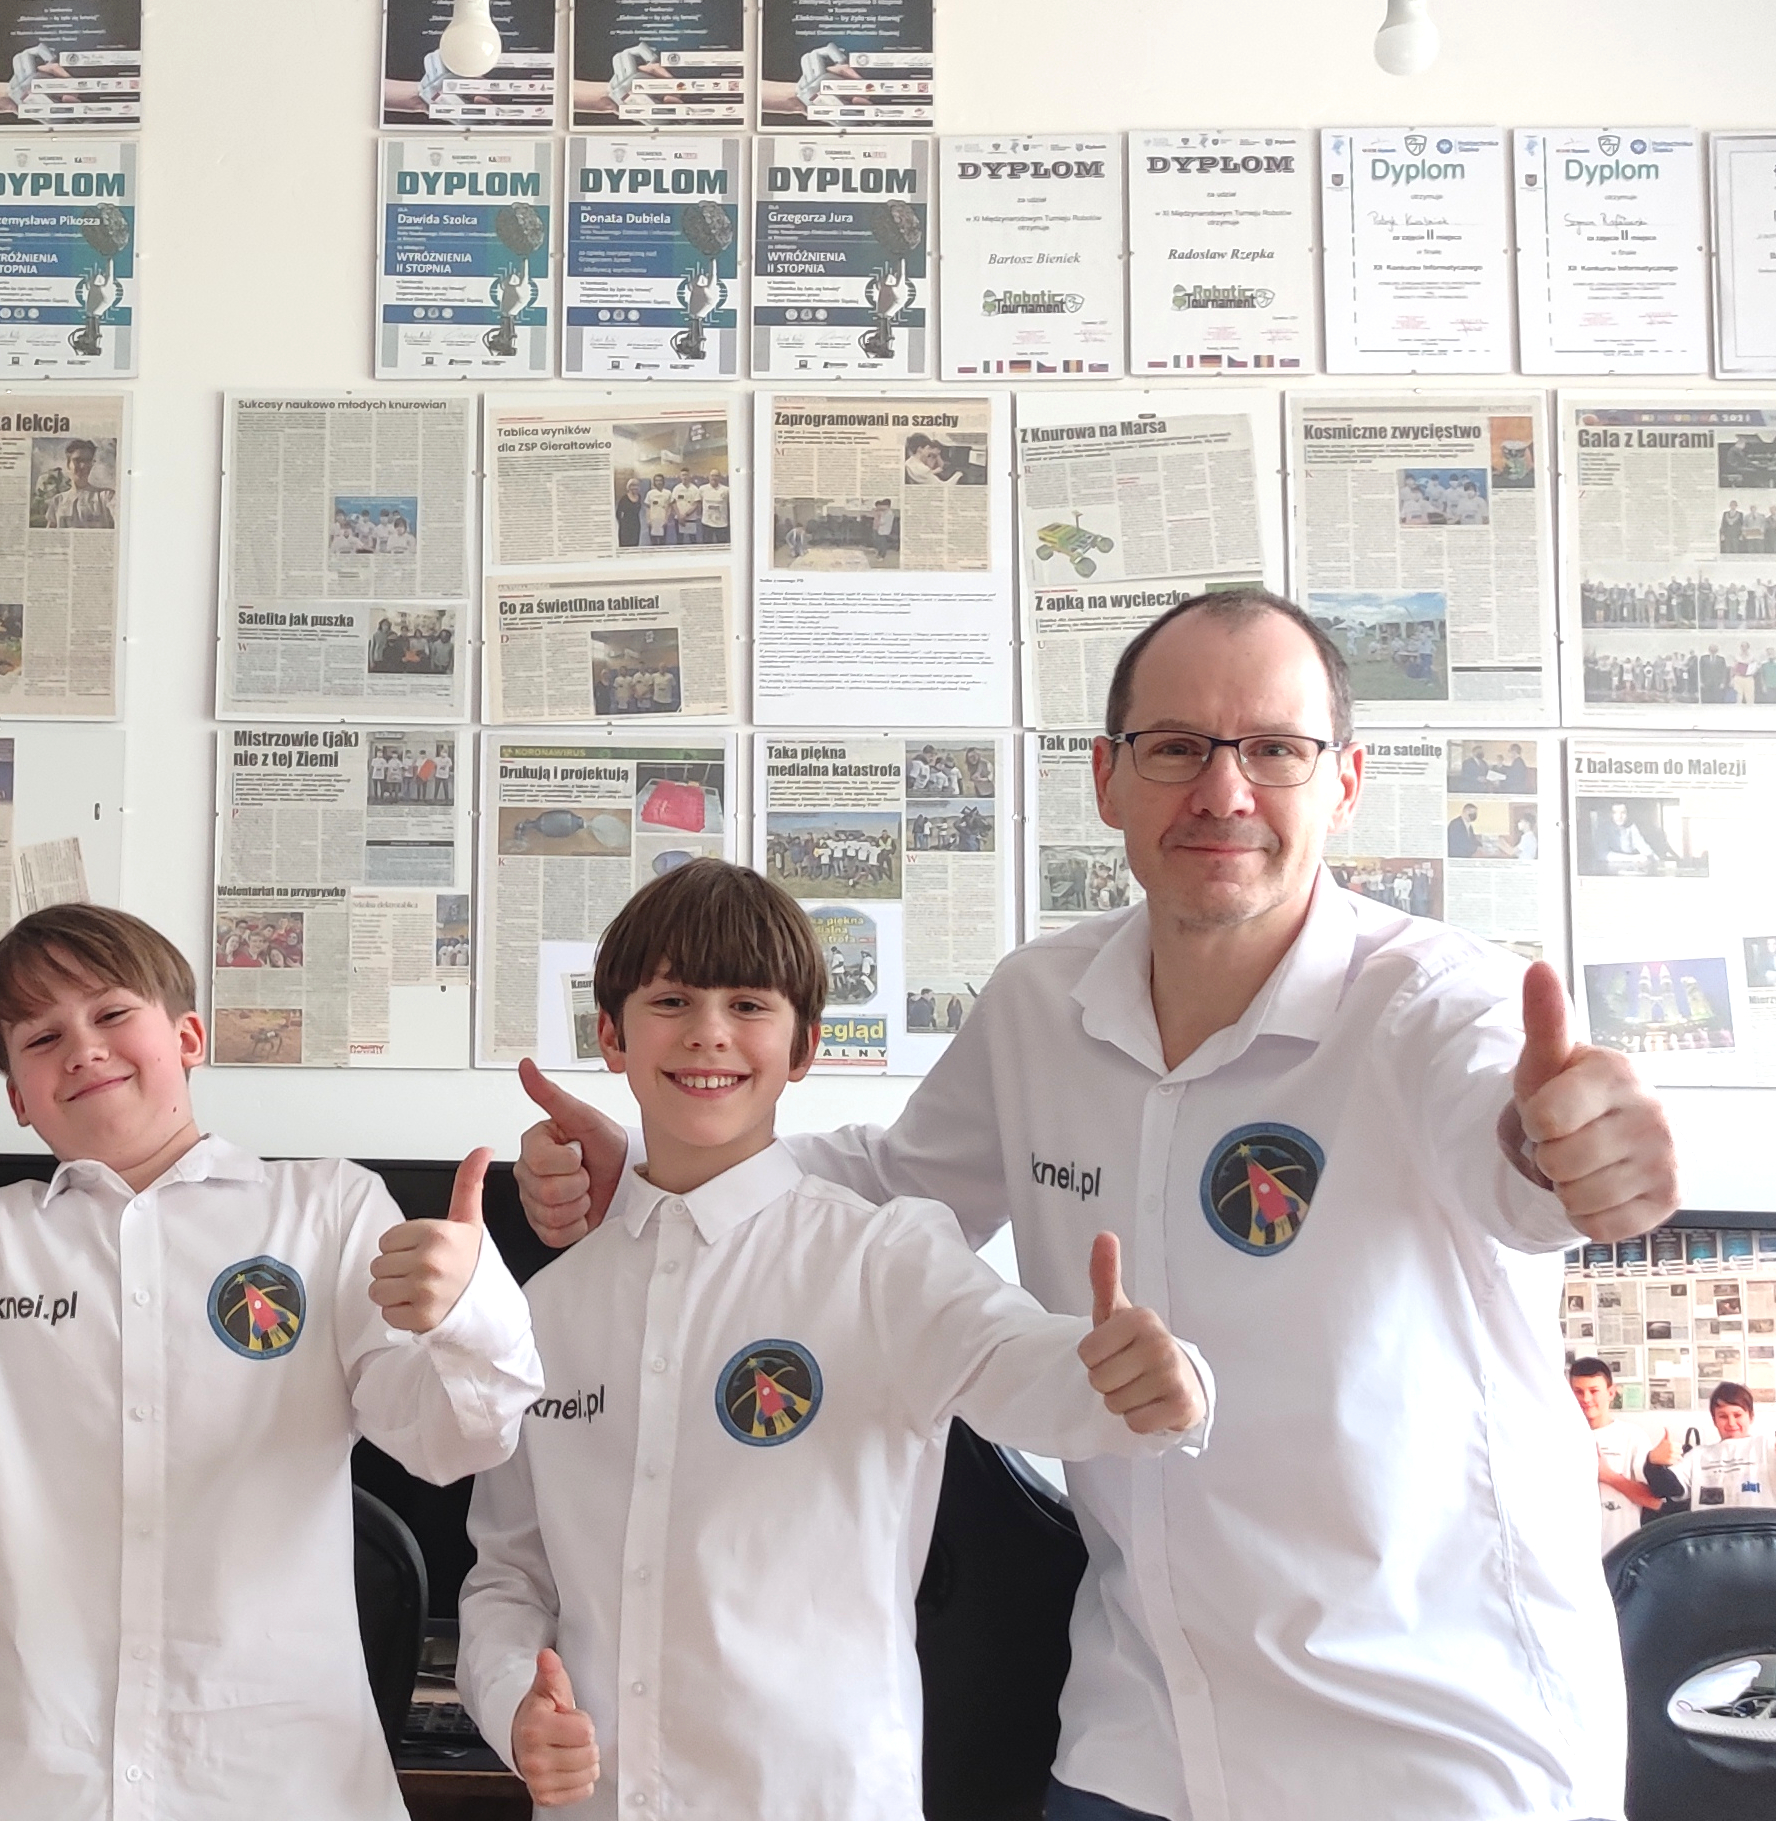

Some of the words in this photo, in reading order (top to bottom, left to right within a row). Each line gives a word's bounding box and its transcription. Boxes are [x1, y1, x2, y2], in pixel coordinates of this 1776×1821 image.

[958, 160, 1106, 180] DYPLOM
[1146, 156, 1295, 174] DYPLOM
[1371, 158, 1465, 187] Dyplom
[580, 168, 728, 194] DYPLOM
[768, 166, 916, 194] DYPLOM
[1564, 159, 1659, 188] Dyplom
[397, 172, 540, 196] DYPLOM
[60, 214, 100, 226] Pikosza
[398, 214, 440, 224] Dawida
[580, 213, 623, 224] Donata
[626, 214, 671, 224] Dubiela
[768, 212, 826, 224] Grzegorza
[828, 213, 854, 222] Jura
[396, 250, 472, 262] WYRÓŻNIENIA
[768, 250, 846, 262] WYRÓŻNIENIA
[988, 254, 1034, 264] Bartosz
[1036, 252, 1082, 264] Bieniek
[1230, 249, 1274, 262] Rzepka
[396, 264, 403, 272] II
[405, 264, 452, 274] STOPNIA
[767, 264, 774, 273] II
[776, 264, 826, 274] STOPNIA
[994, 299, 1066, 314] Tournament
[1184, 293, 1256, 309] Tournament
[238, 400, 282, 412] Sukcesy
[338, 399, 386, 412] młodych
[388, 400, 447, 410] knurowian
[15, 413, 70, 435] lekcja
[774, 411, 888, 430] Zaprogramowani
[892, 414, 908, 428] na
[911, 412, 960, 430] szachy
[497, 426, 539, 438] Tablica
[540, 424, 592, 438] wyników
[1020, 428, 1028, 444] Z
[1031, 424, 1096, 443] Knurowa
[1100, 423, 1118, 437] na
[1120, 420, 1167, 436] Marsa
[1304, 422, 1388, 442] Kosmiczne
[1390, 424, 1482, 443] zwycięstwo
[1578, 429, 1620, 448] Gala
[1624, 432, 1634, 448] z
[1637, 429, 1714, 448] Laurami
[497, 442, 516, 452] dla
[518, 441, 538, 452] ZSP
[499, 602, 517, 615] Co
[520, 602, 534, 614] za
[608, 595, 660, 610] tablica!
[1034, 595, 1044, 612] Z
[1046, 594, 1084, 613] apką
[1088, 594, 1108, 610] na
[238, 612, 288, 628] Satelita
[288, 612, 309, 629] jak
[310, 612, 354, 628] puszka
[234, 730, 320, 748] Mistrzowie
[322, 730, 360, 748] (jak)
[1038, 735, 1065, 750] Tak
[234, 751, 258, 766] nie
[260, 754, 269, 766] z
[270, 751, 292, 768] tej
[294, 750, 339, 767] Ziemi
[515, 748, 586, 758] KORONAWIRUS
[766, 746, 798, 760] Taka
[800, 746, 846, 762] piękna
[1378, 746, 1390, 756] za
[1394, 744, 1442, 759] satelitę
[500, 766, 551, 781] Drukują
[561, 767, 630, 783] projektują
[767, 763, 830, 777] medialna
[832, 763, 902, 777] katastrofa
[1664, 759, 1684, 775] do
[1688, 758, 1746, 777] Malezji
[1030, 1152, 1101, 1201] knei.pl
